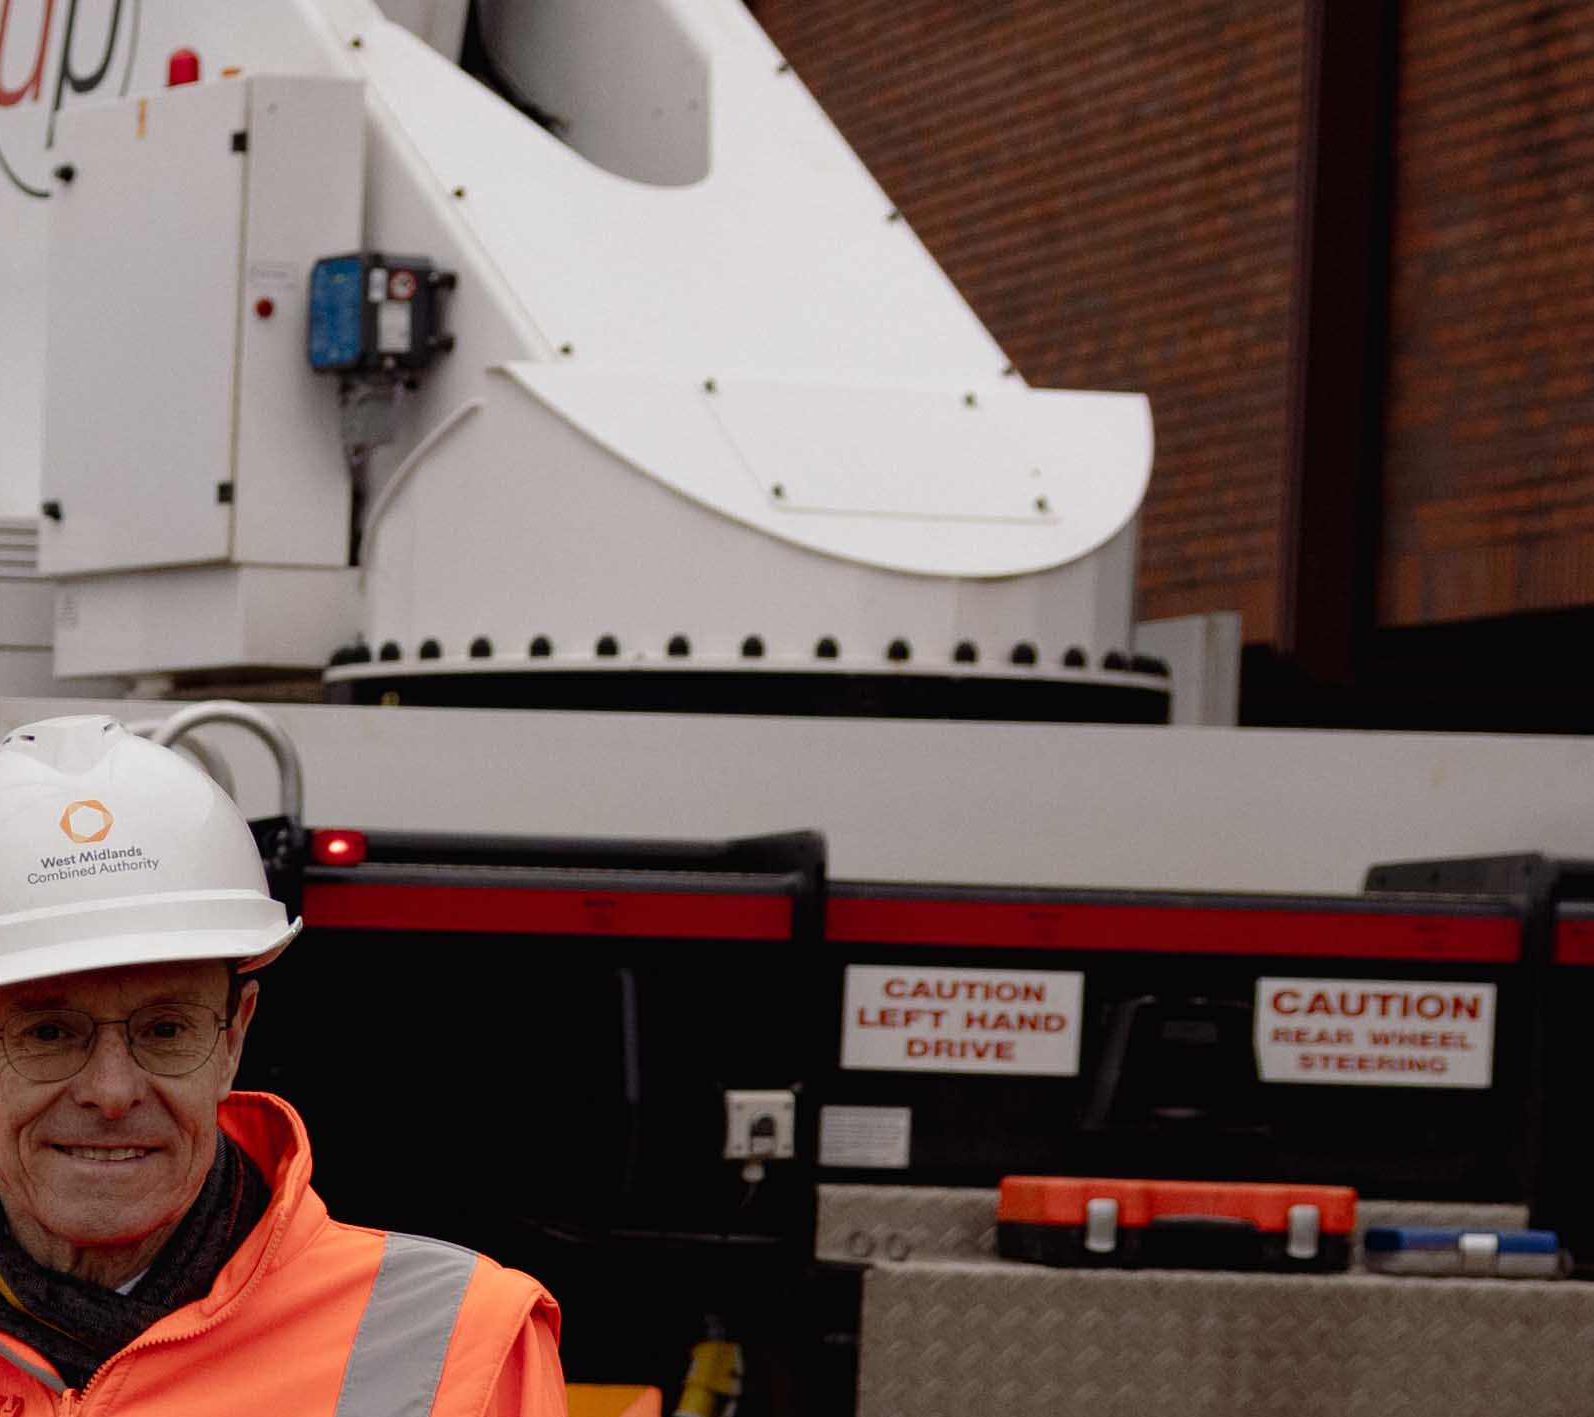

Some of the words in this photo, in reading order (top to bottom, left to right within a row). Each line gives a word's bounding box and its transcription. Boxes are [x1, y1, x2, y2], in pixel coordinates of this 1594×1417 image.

[40, 854, 76, 869] West
[79, 845, 143, 864] Midlands
[27, 865, 97, 885] Combined
[99, 857, 160, 874] Authority
[883, 978, 1047, 1003] CAUTION
[1271, 990, 1483, 1022] CAUTION
[856, 1007, 948, 1029] LEFT
[964, 1011, 1067, 1034] HAND
[905, 1038, 1017, 1061] DRIVE
[1271, 1027, 1354, 1046] REAR
[1369, 1030, 1475, 1051] WHEEL
[1297, 1053, 1449, 1074] STEERING
